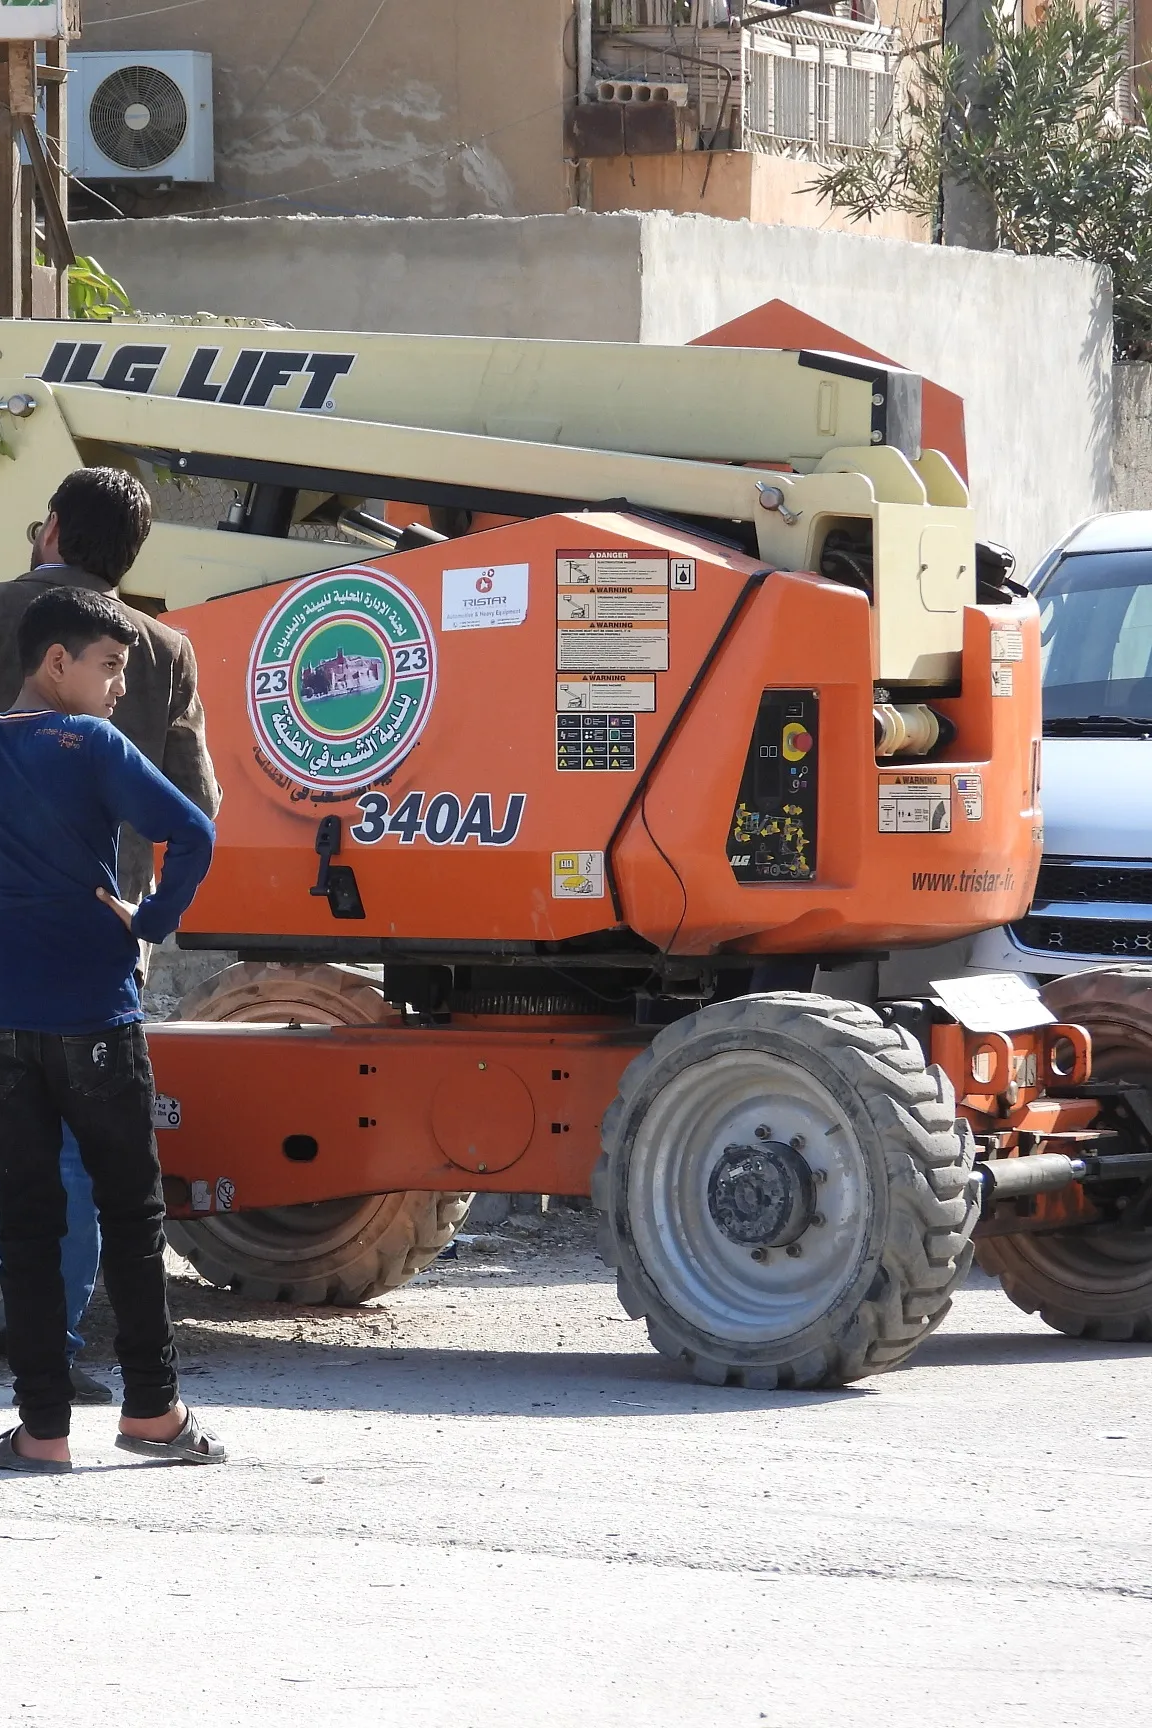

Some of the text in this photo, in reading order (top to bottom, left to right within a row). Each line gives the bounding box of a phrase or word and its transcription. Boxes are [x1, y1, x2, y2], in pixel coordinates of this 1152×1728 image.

[177, 345, 358, 410] LIFT
[333, 589, 363, 604] المحلية
[462, 596, 507, 607] TRISTAR
[389, 610, 407, 637] لجنة
[480, 610, 494, 618] Heavy
[496, 608, 521, 616] Equipment
[273, 613, 306, 658] والبلديات
[395, 646, 428, 673] 23
[256, 670, 288, 695] 23
[272, 704, 313, 760] الطبقة
[372, 694, 418, 745] بلدية
[309, 744, 330, 776] في
[330, 735, 378, 774] الشعب
[903, 776, 938, 784] WARNING
[350, 791, 528, 846] 340AJ
[729, 855, 752, 866] JLG
[912, 868, 1015, 892] www.tristar-ir
